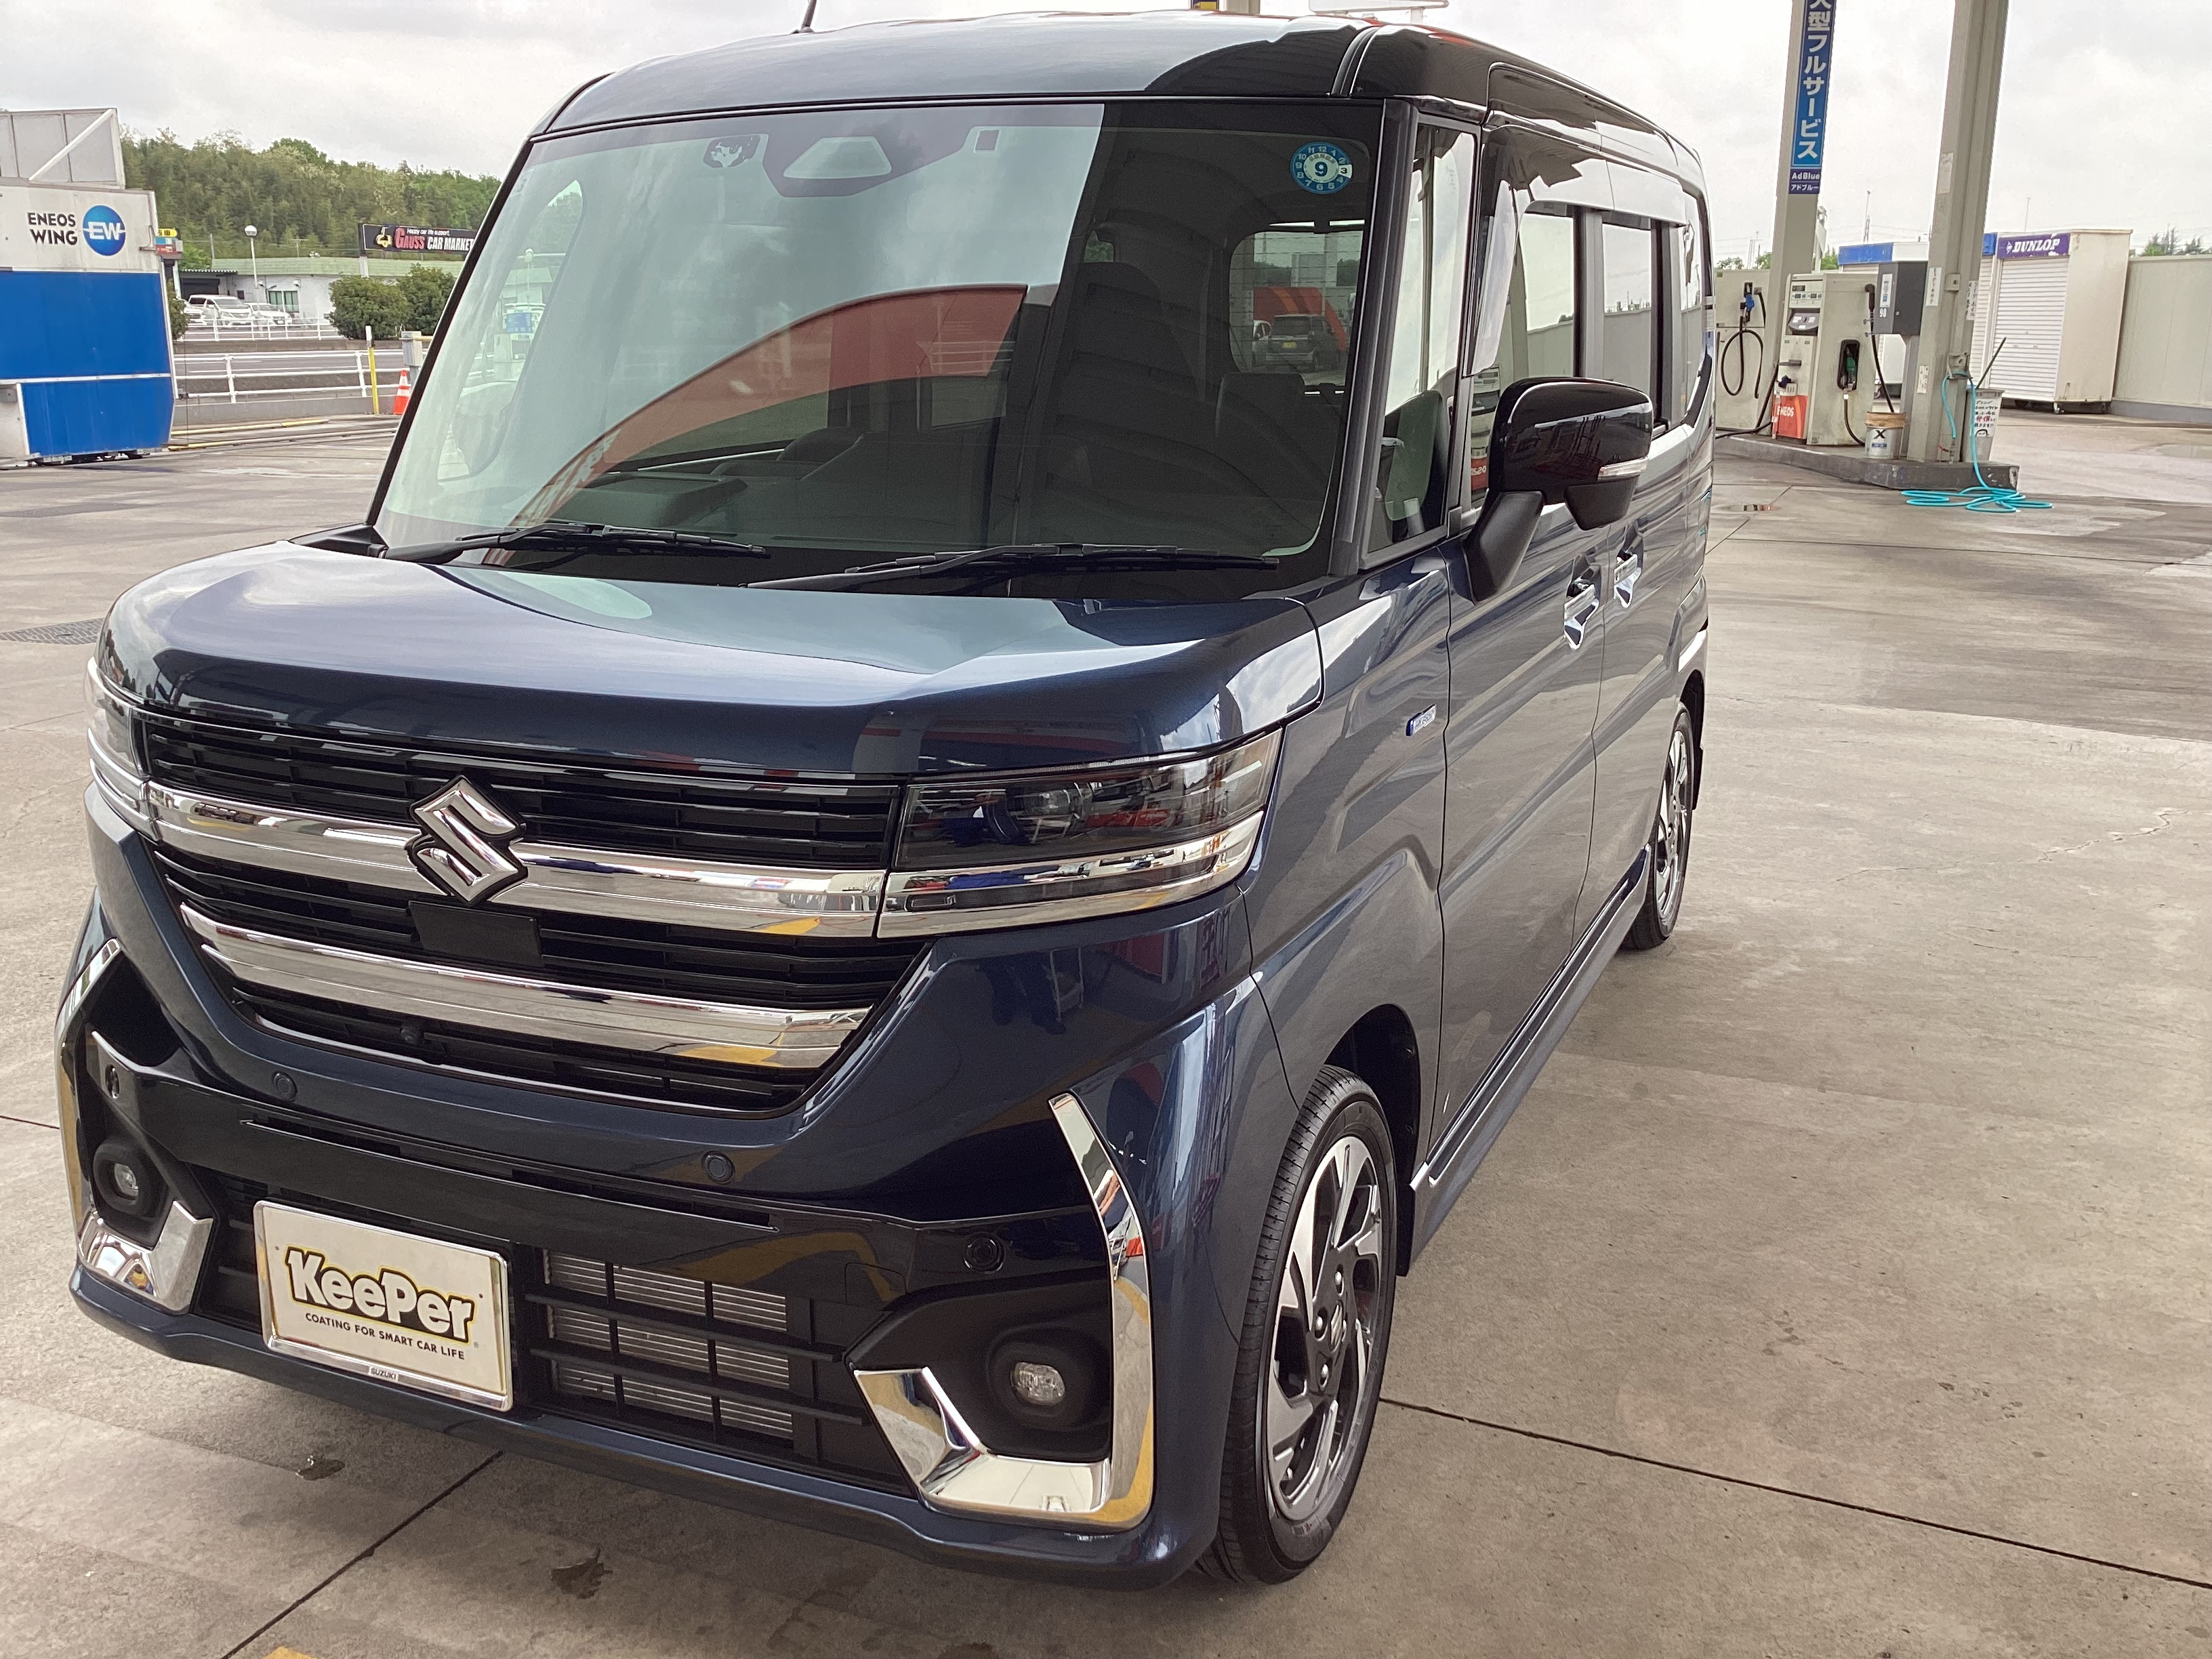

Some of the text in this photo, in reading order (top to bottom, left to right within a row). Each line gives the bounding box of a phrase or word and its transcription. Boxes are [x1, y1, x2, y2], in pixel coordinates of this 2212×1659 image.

[1315, 161, 1328, 177] 9
[1792, 172, 1820, 180] AdBlue
[1790, 184, 1819, 192] アドブルー
[27, 212, 76, 228] ENEOS
[29, 228, 78, 245] WING
[87, 221, 121, 241] EW
[427, 237, 444, 250] CAR
[2012, 238, 2060, 253] DUNLOP
[1777, 405, 1795, 417] ENEOS
[285, 1246, 476, 1343] KeePer
[305, 1313, 465, 1360] COATING FOR SMART CAR LIFE
[370, 1368, 397, 1380] SUZUKI
